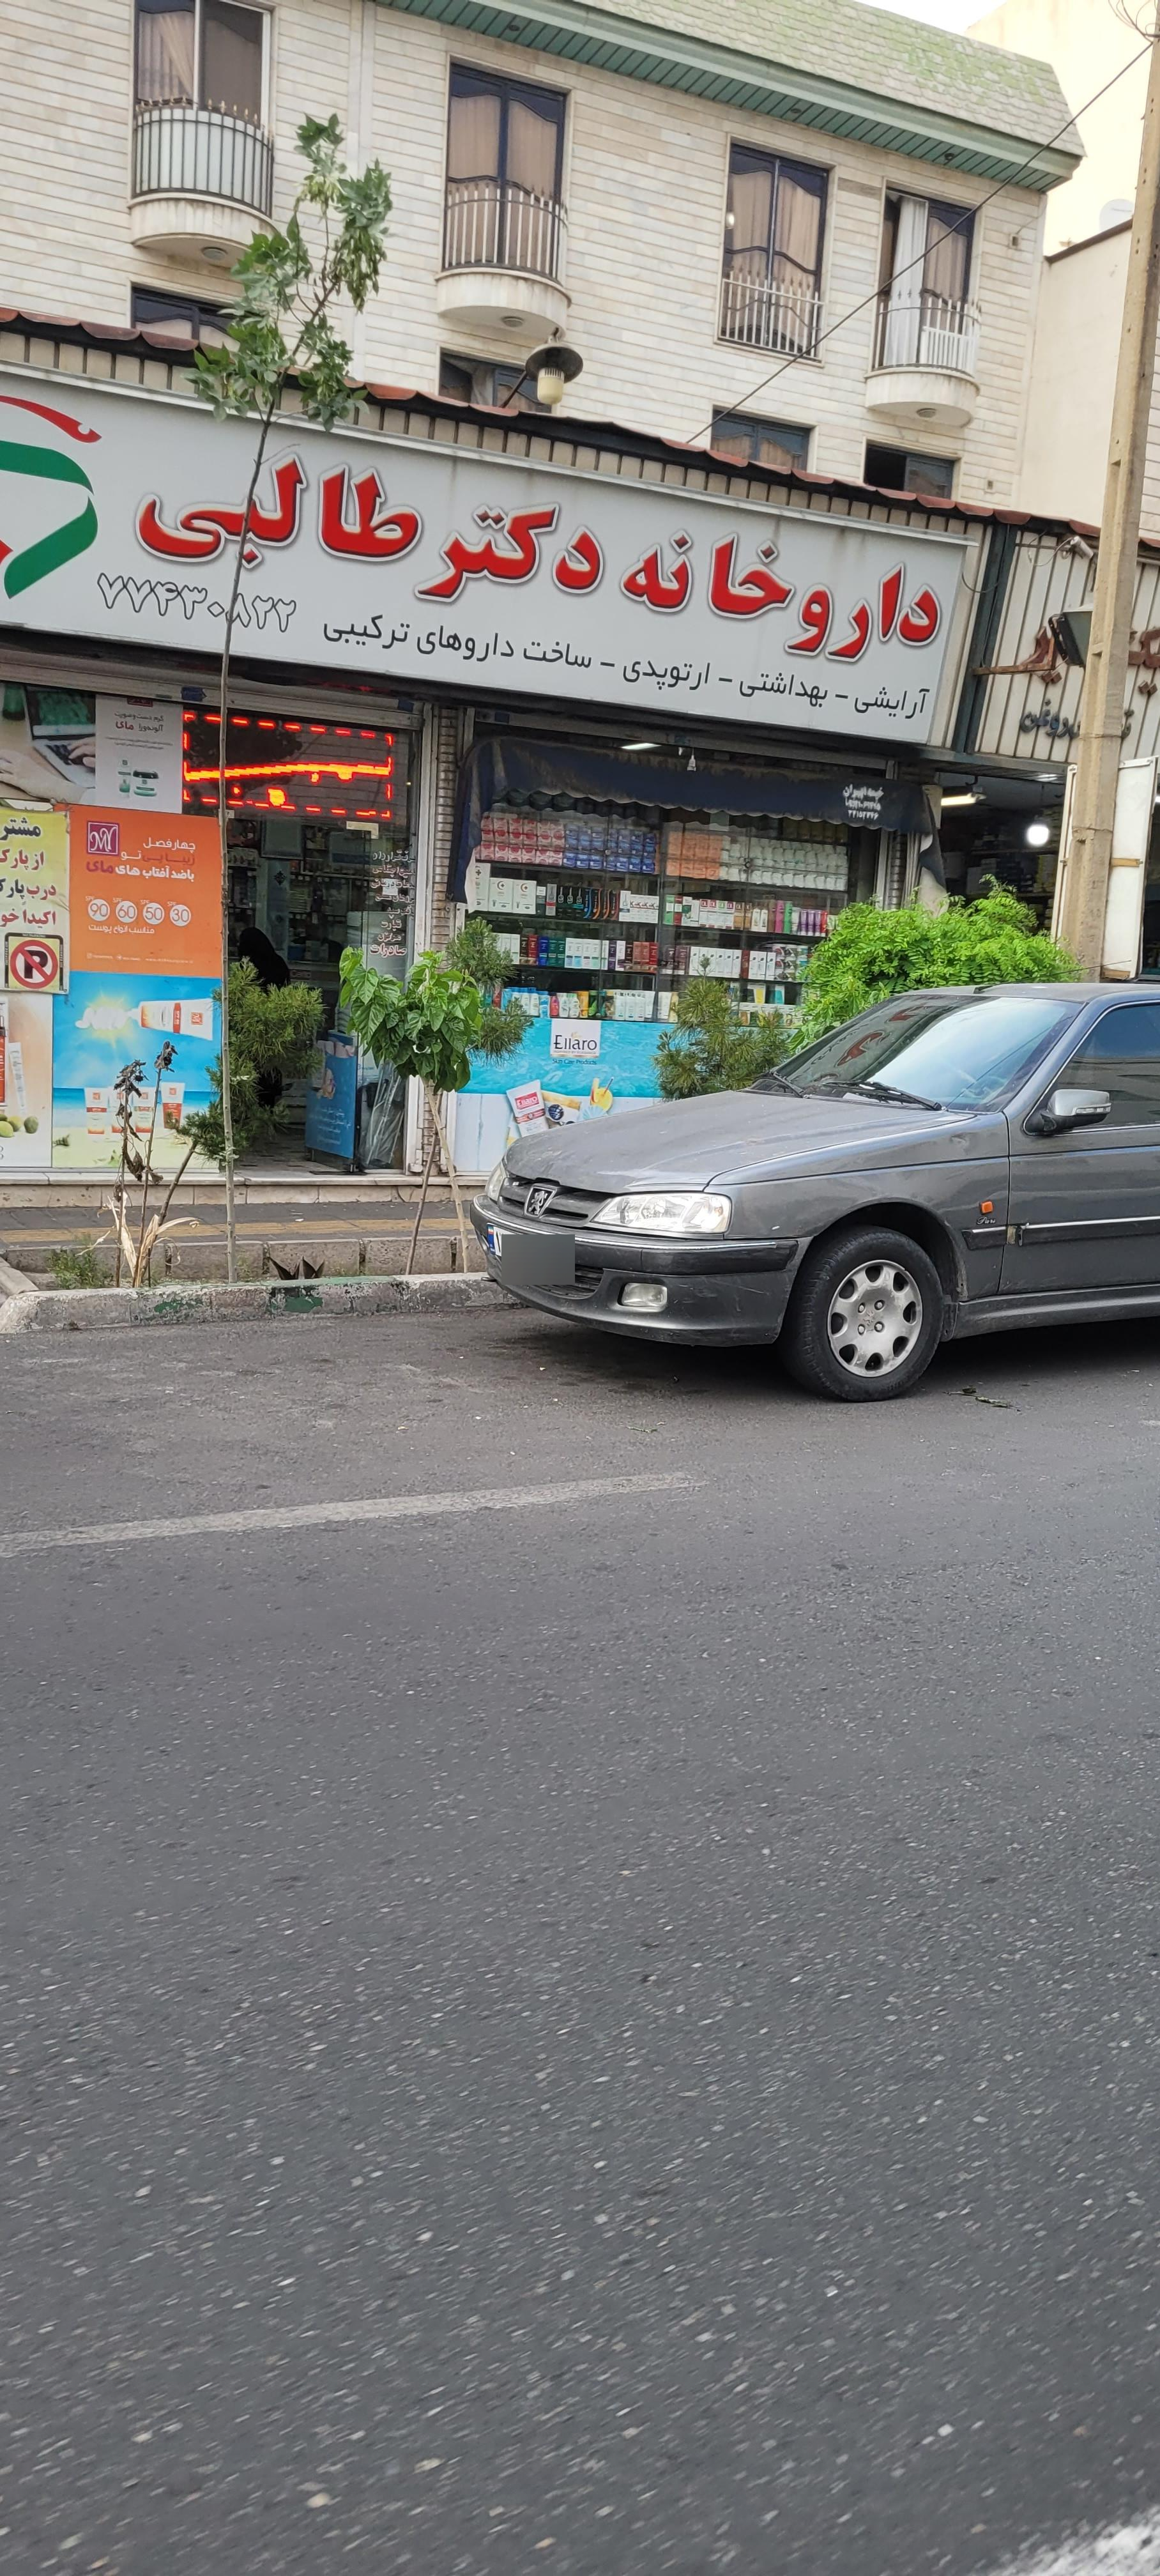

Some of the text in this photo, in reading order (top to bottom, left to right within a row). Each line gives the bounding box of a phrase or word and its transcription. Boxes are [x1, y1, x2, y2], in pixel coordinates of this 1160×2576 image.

[134, 452, 423, 568] طالبی
[415, 502, 604, 602] دکتر
[96, 572, 297, 633] ۷۷۴۳۰۸۲۲
[621, 529, 943, 662] داروخانه
[323, 614, 930, 719] آرایشی بهداشتی ارتوپدی ساخت داروهای ترکیبی
[32, 851, 44, 870] از
[86, 860, 113, 873] مای
[115, 864, 141, 875] های
[26, 885, 56, 900] درب
[89, 903, 109, 917] 90
[118, 905, 136, 919] 60
[144, 907, 163, 921] 50
[172, 908, 190, 923] 30
[370, 943, 408, 958] صادرات
